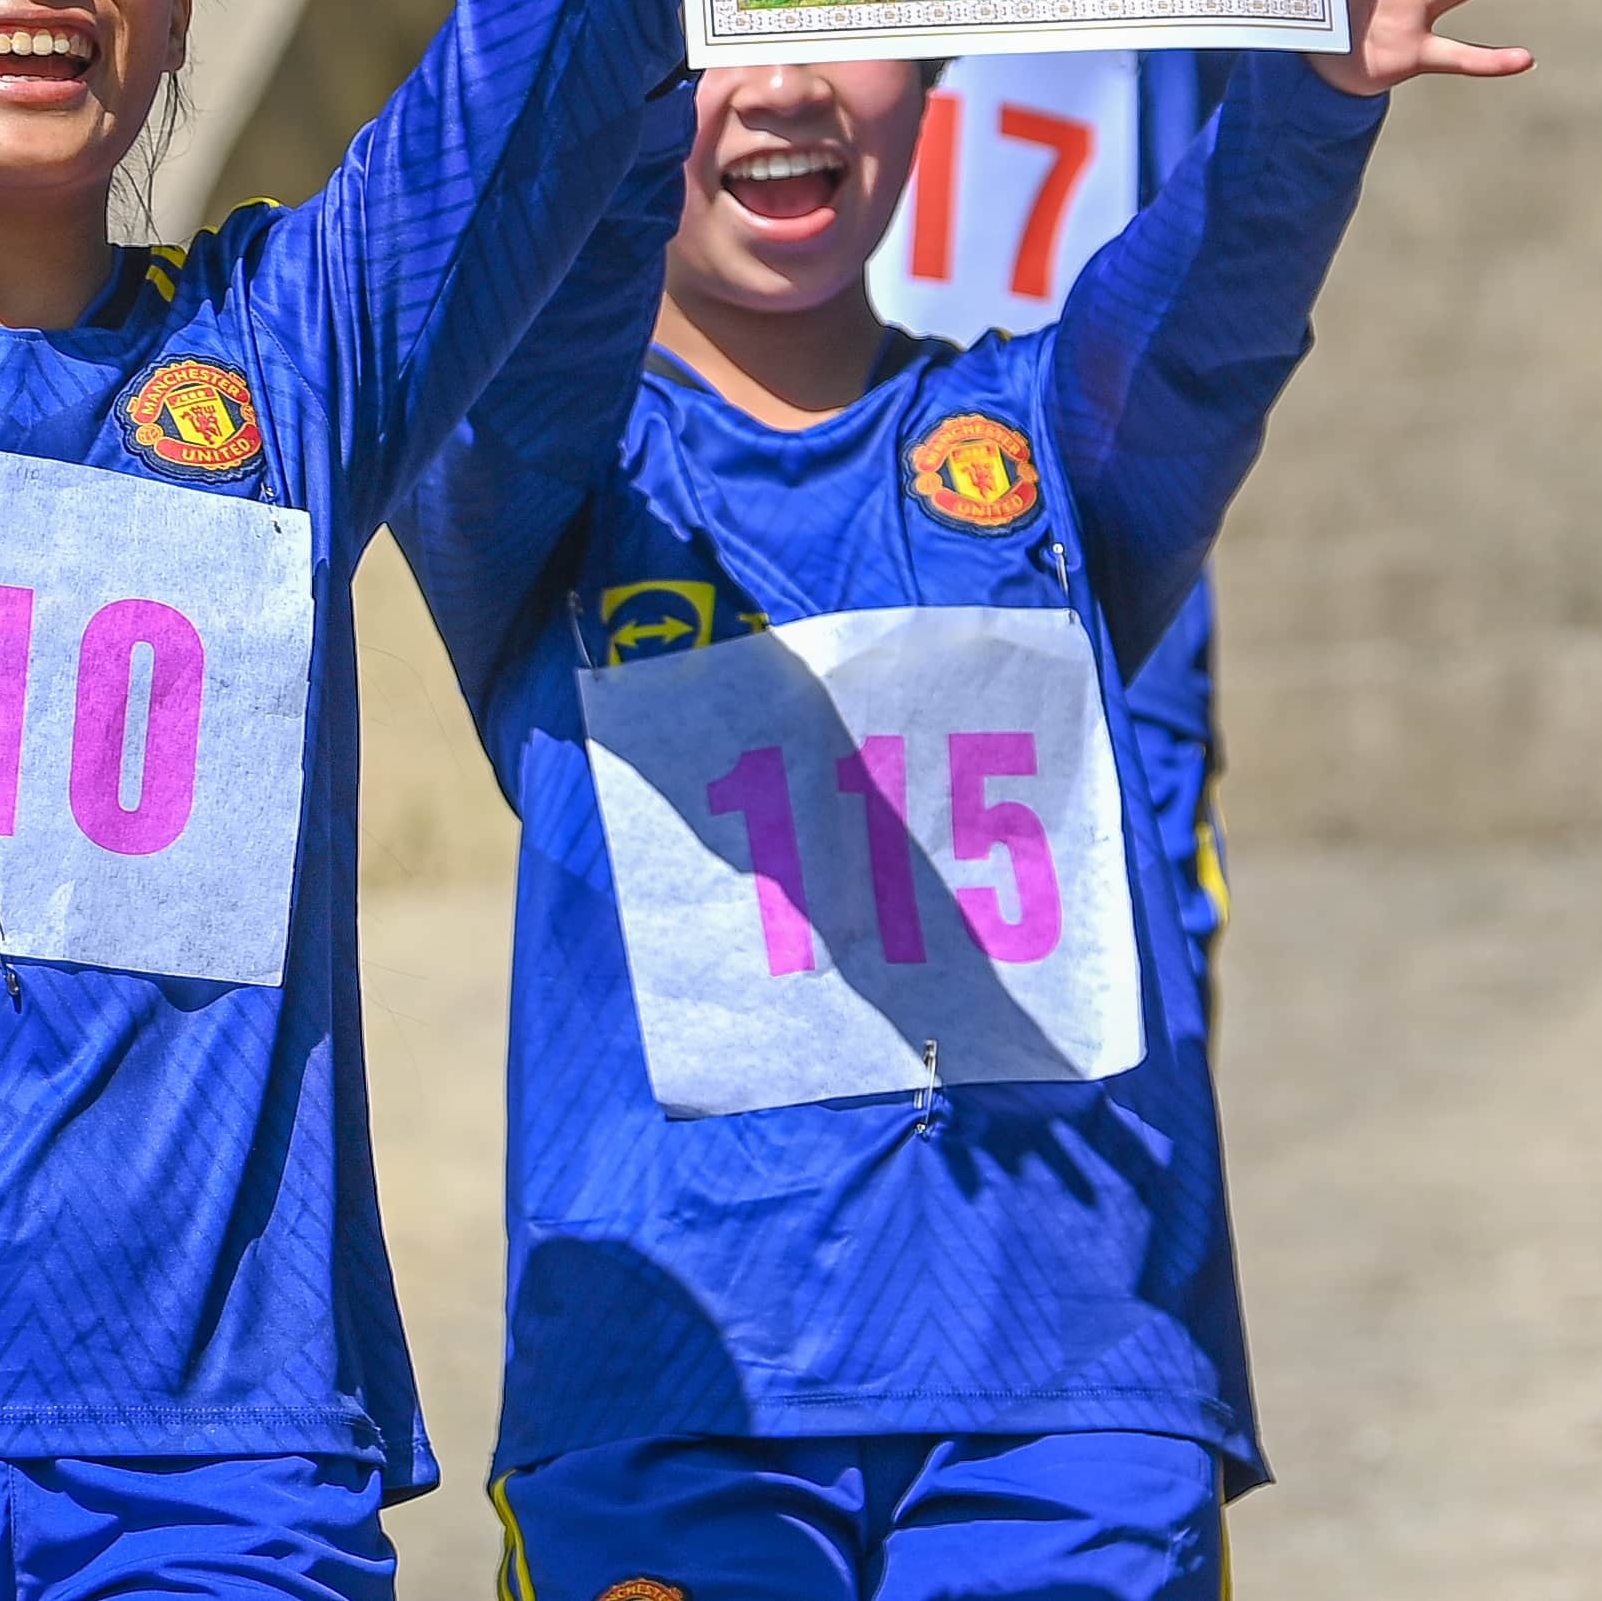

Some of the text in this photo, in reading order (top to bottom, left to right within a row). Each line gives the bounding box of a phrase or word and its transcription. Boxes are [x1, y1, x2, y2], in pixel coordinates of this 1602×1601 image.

[141, 368, 241, 415] MANCHESTER
[182, 438, 250, 462] UNITED
[957, 493, 1024, 517] UNITED
[706, 731, 1063, 978] 115
